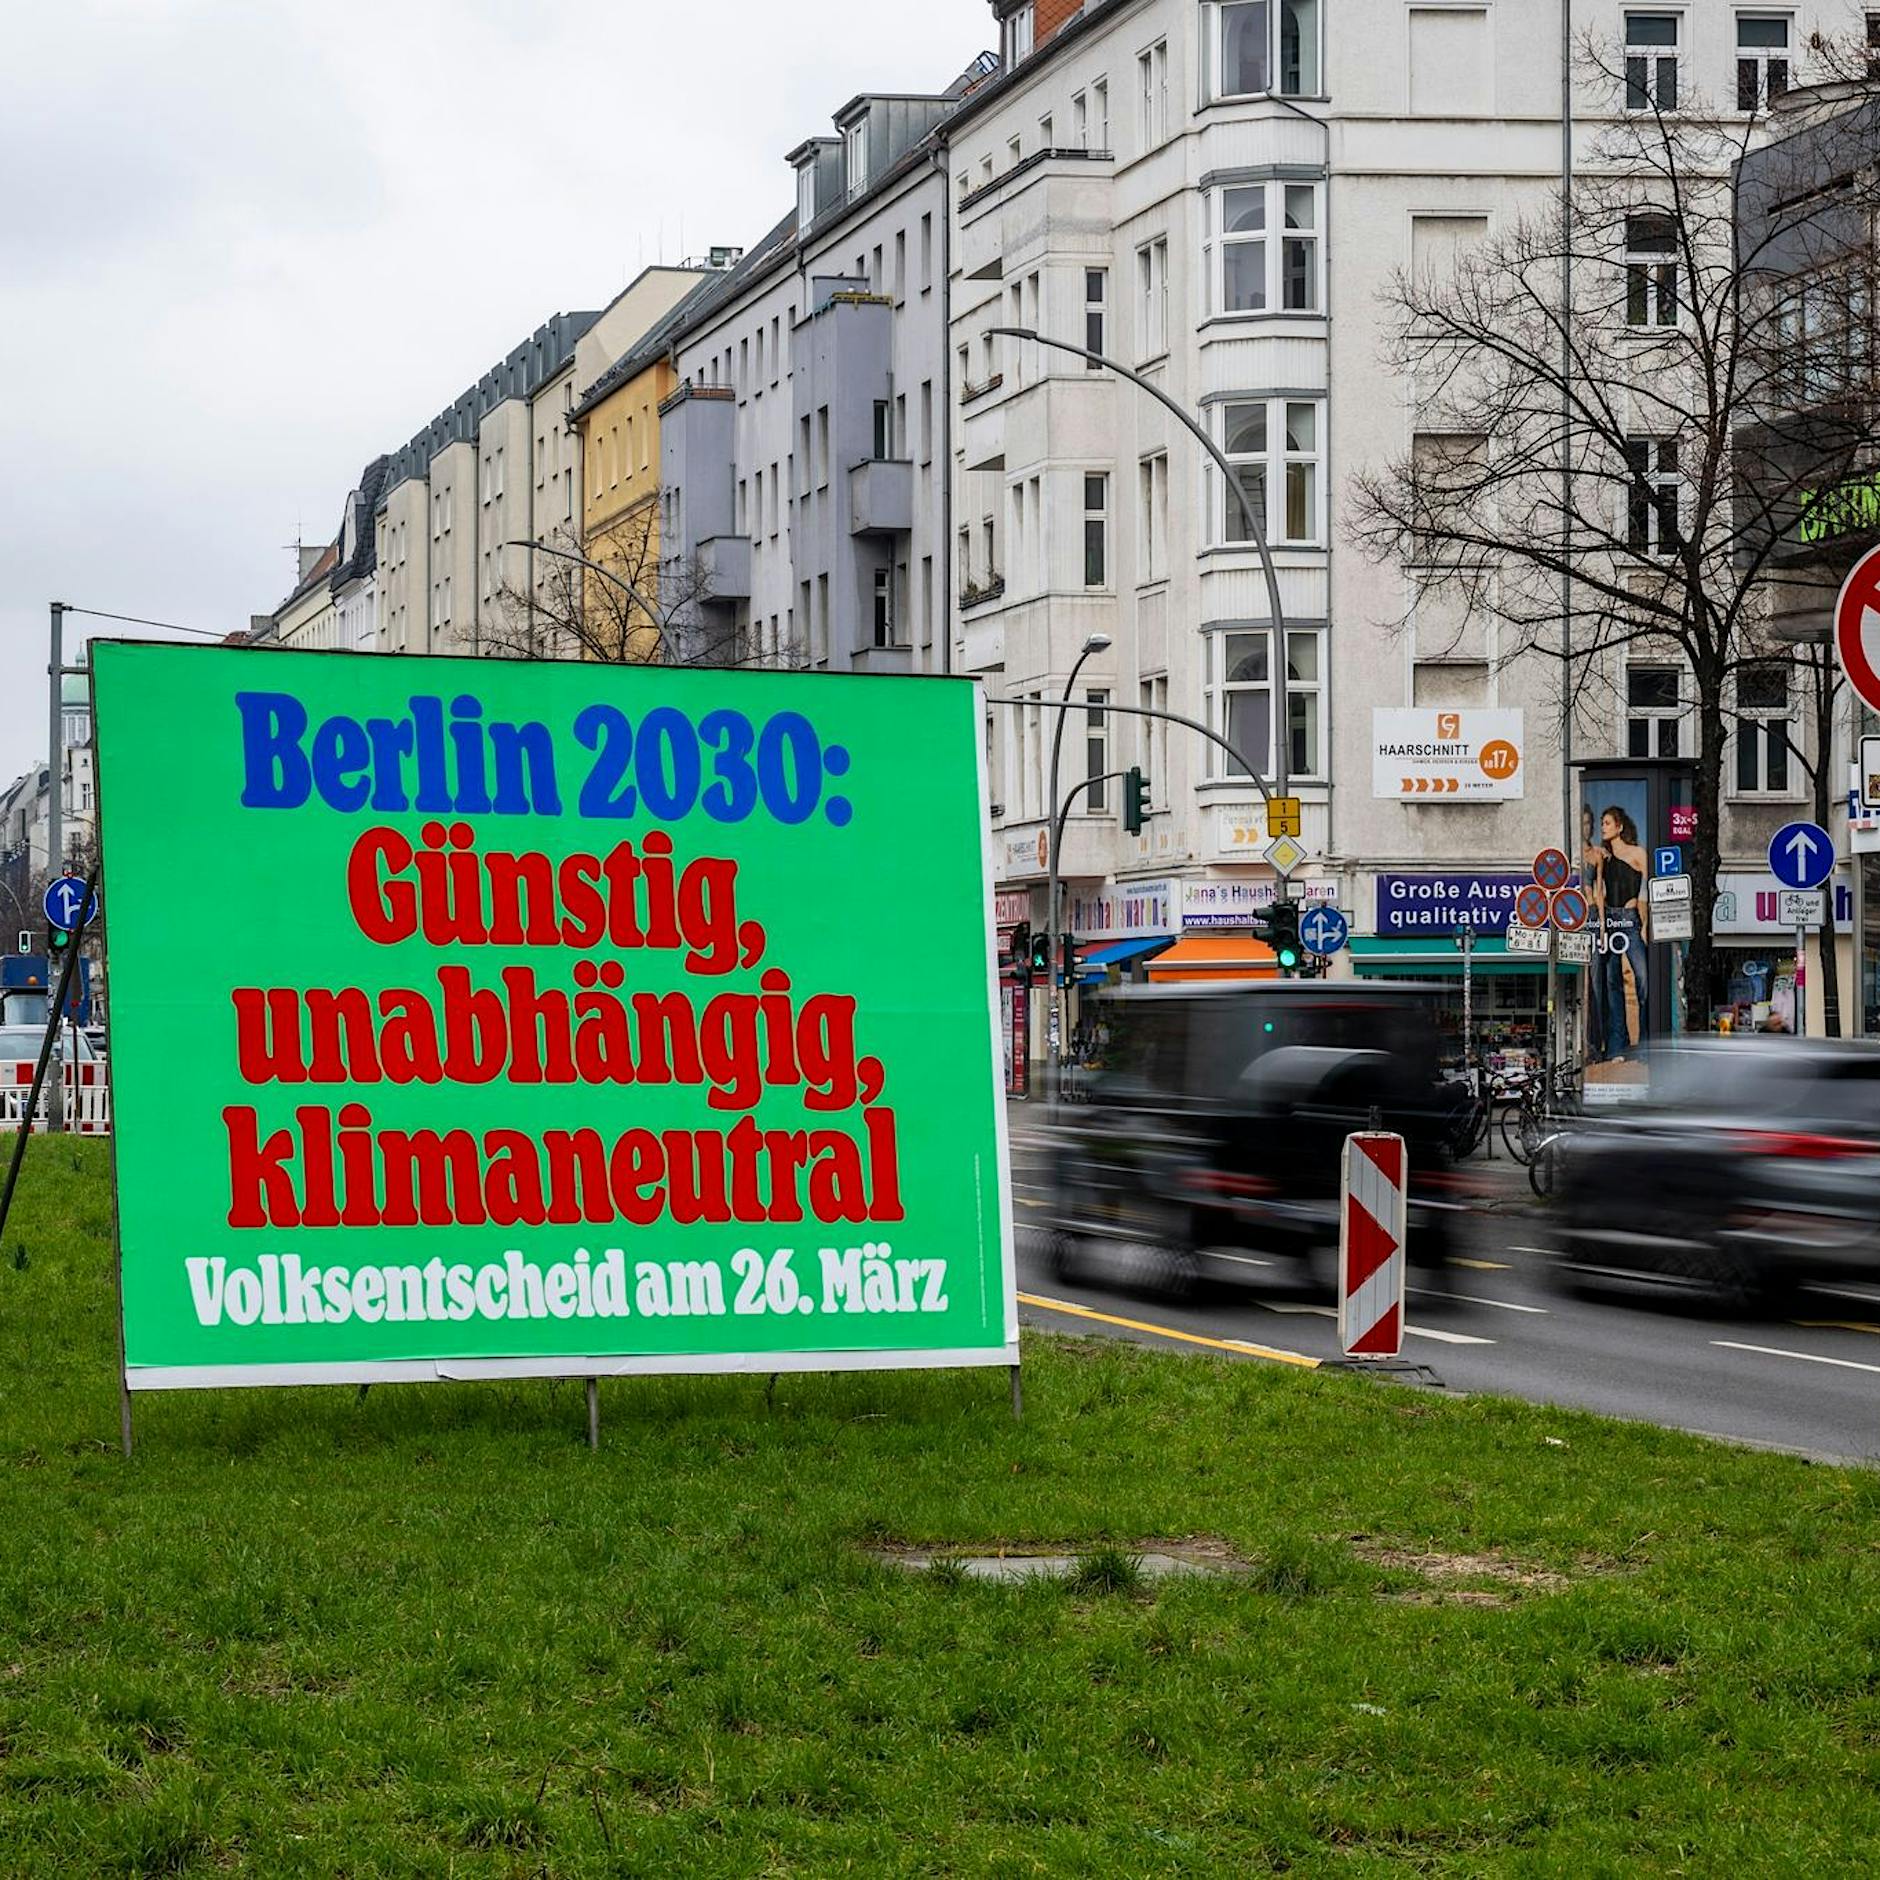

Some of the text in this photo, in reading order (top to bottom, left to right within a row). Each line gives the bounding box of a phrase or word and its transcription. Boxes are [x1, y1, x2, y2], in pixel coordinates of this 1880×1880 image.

[235, 690, 853, 827] Berlin 2030:
[1379, 744, 1470, 756] HAARSCHNITT
[1492, 750, 1508, 769] 17
[1280, 821, 1288, 833] 5
[348, 821, 766, 975] Günstig,
[1390, 881, 1460, 899] Große
[1390, 907, 1501, 926] qualitativ
[1607, 918, 1634, 929] Denim
[232, 961, 886, 1111] unabhängig,
[223, 1103, 904, 1228] klimaneutral
[185, 1243, 949, 1326] Volksentscheid am 26. März
